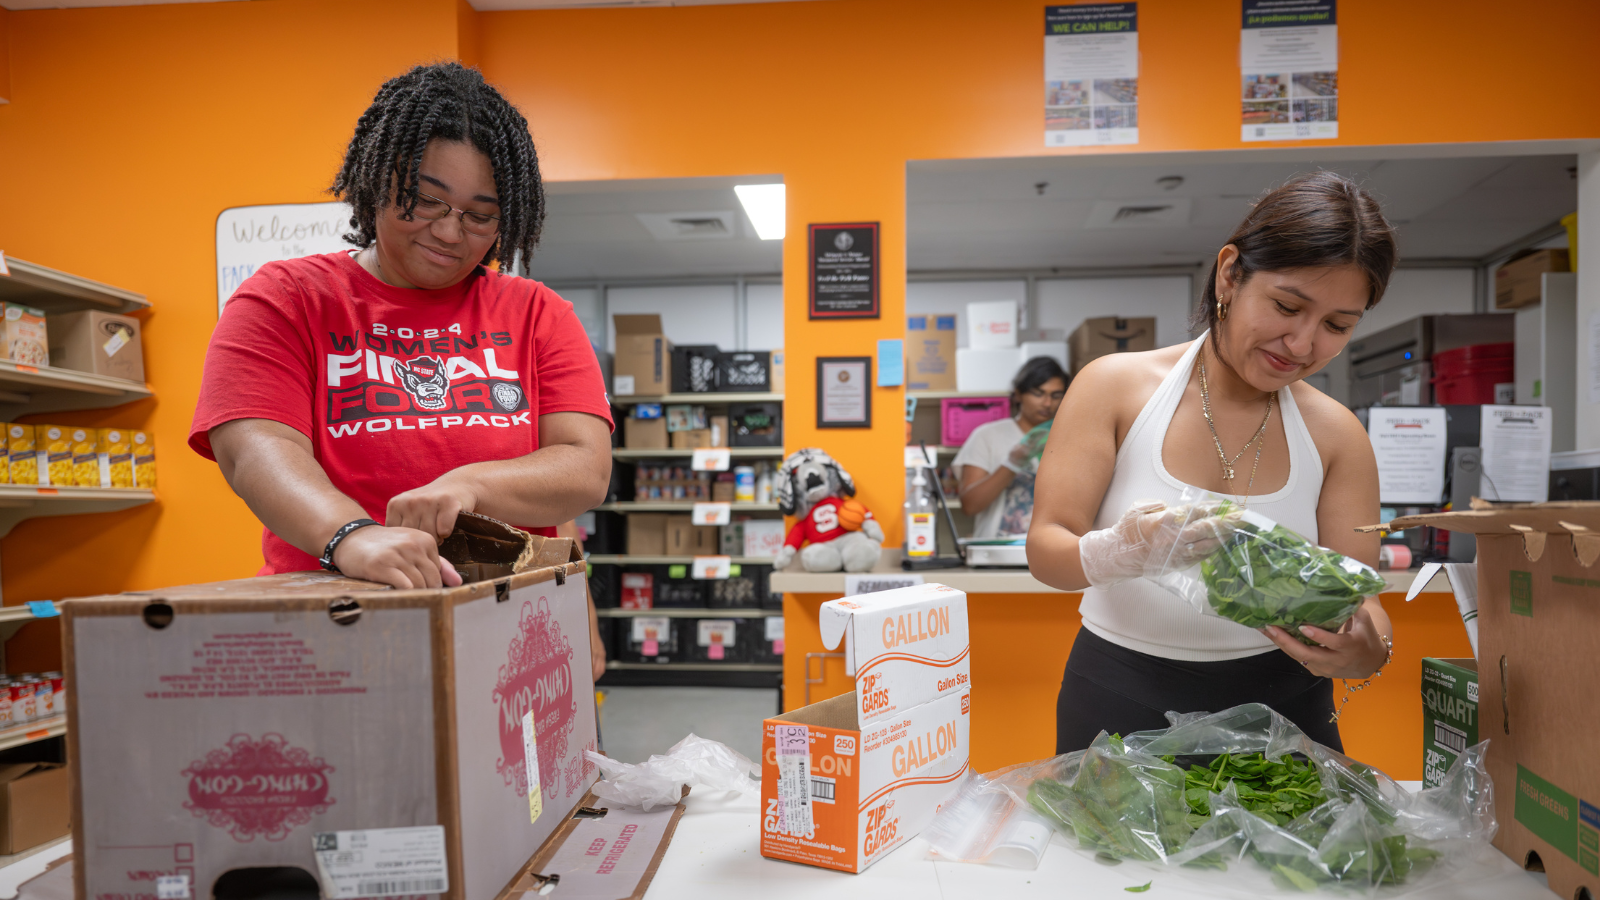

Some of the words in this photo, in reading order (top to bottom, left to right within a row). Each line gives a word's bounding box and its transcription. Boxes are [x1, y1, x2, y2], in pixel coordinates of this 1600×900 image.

[1052, 23, 1071, 33] WE
[1072, 22, 1097, 33] CAN
[1098, 20, 1130, 32] HELP!
[232, 215, 350, 243] Welcome
[329, 329, 513, 356] WOMEN'S
[421, 367, 435, 376] STATE
[327, 412, 531, 439] WOLFPACK
[1412, 417, 1431, 425] PACK
[1493, 410, 1514, 418] FEED
[1521, 410, 1544, 419] PACK
[813, 503, 839, 534] S
[857, 580, 915, 594] REMINDER
[882, 605, 950, 650] GALLON
[862, 674, 876, 695] ZIP
[937, 677, 956, 692] Gallon
[956, 673, 968, 686] Size
[1468, 684, 1478, 695] 500
[862, 687, 889, 714] GARDS
[961, 695, 969, 708] 250
[1426, 687, 1476, 726] QUART
[545, 708, 560, 732] FRESH
[864, 735, 871, 743] LD
[890, 722, 903, 733] Gallon
[902, 719, 912, 729] Size
[836, 738, 854, 749] 250
[864, 741, 882, 753] Reorder
[891, 719, 957, 778] GALLON
[765, 747, 852, 777] GLON
[1426, 748, 1439, 766] ZIP
[1520, 779, 1539, 802] FRESH
[1539, 789, 1569, 821] GREENS
[865, 804, 886, 834] ZIP
[584, 837, 608, 856] KEEP
[764, 832, 776, 840] Low
[777, 835, 799, 845] Density
[799, 838, 830, 850] Resealable
[830, 844, 846, 853] Bags
[863, 816, 899, 857] GARDS
[595, 824, 638, 874] REFRIGERATED
